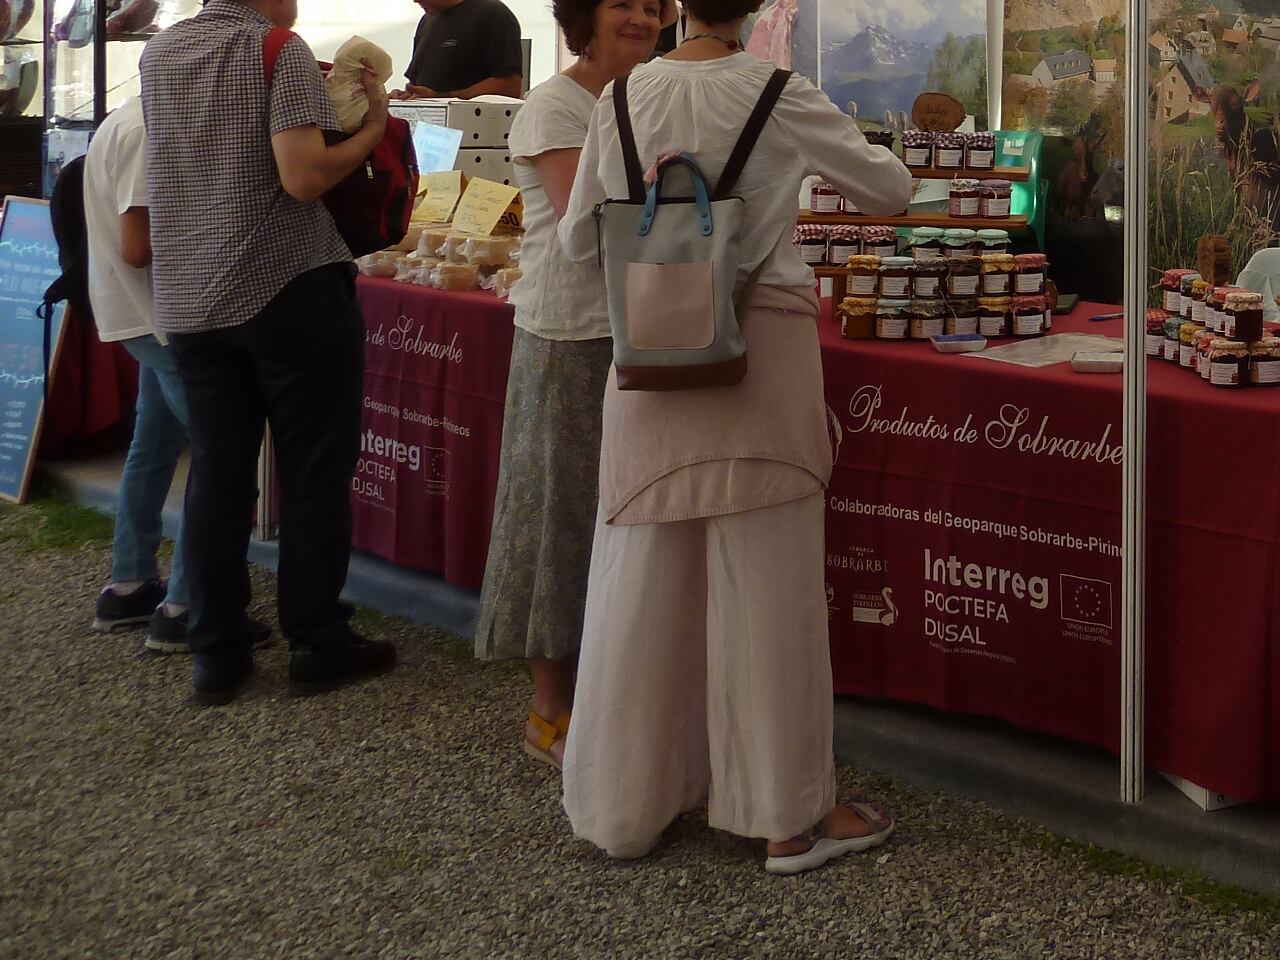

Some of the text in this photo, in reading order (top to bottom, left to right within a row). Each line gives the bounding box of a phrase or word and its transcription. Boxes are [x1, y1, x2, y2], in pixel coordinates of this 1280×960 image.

[372, 315, 463, 363] de Sobrarbe
[847, 384, 1123, 465] Productos de Sobrarbe
[356, 458, 397, 483] OCTEFA
[830, 496, 919, 521] Colaboradoras
[924, 508, 942, 525] del
[944, 512, 1018, 541] Geoparque
[924, 548, 1049, 609] Interreg
[925, 589, 1010, 624] POCTEFA
[925, 617, 987, 645] DUSAL
